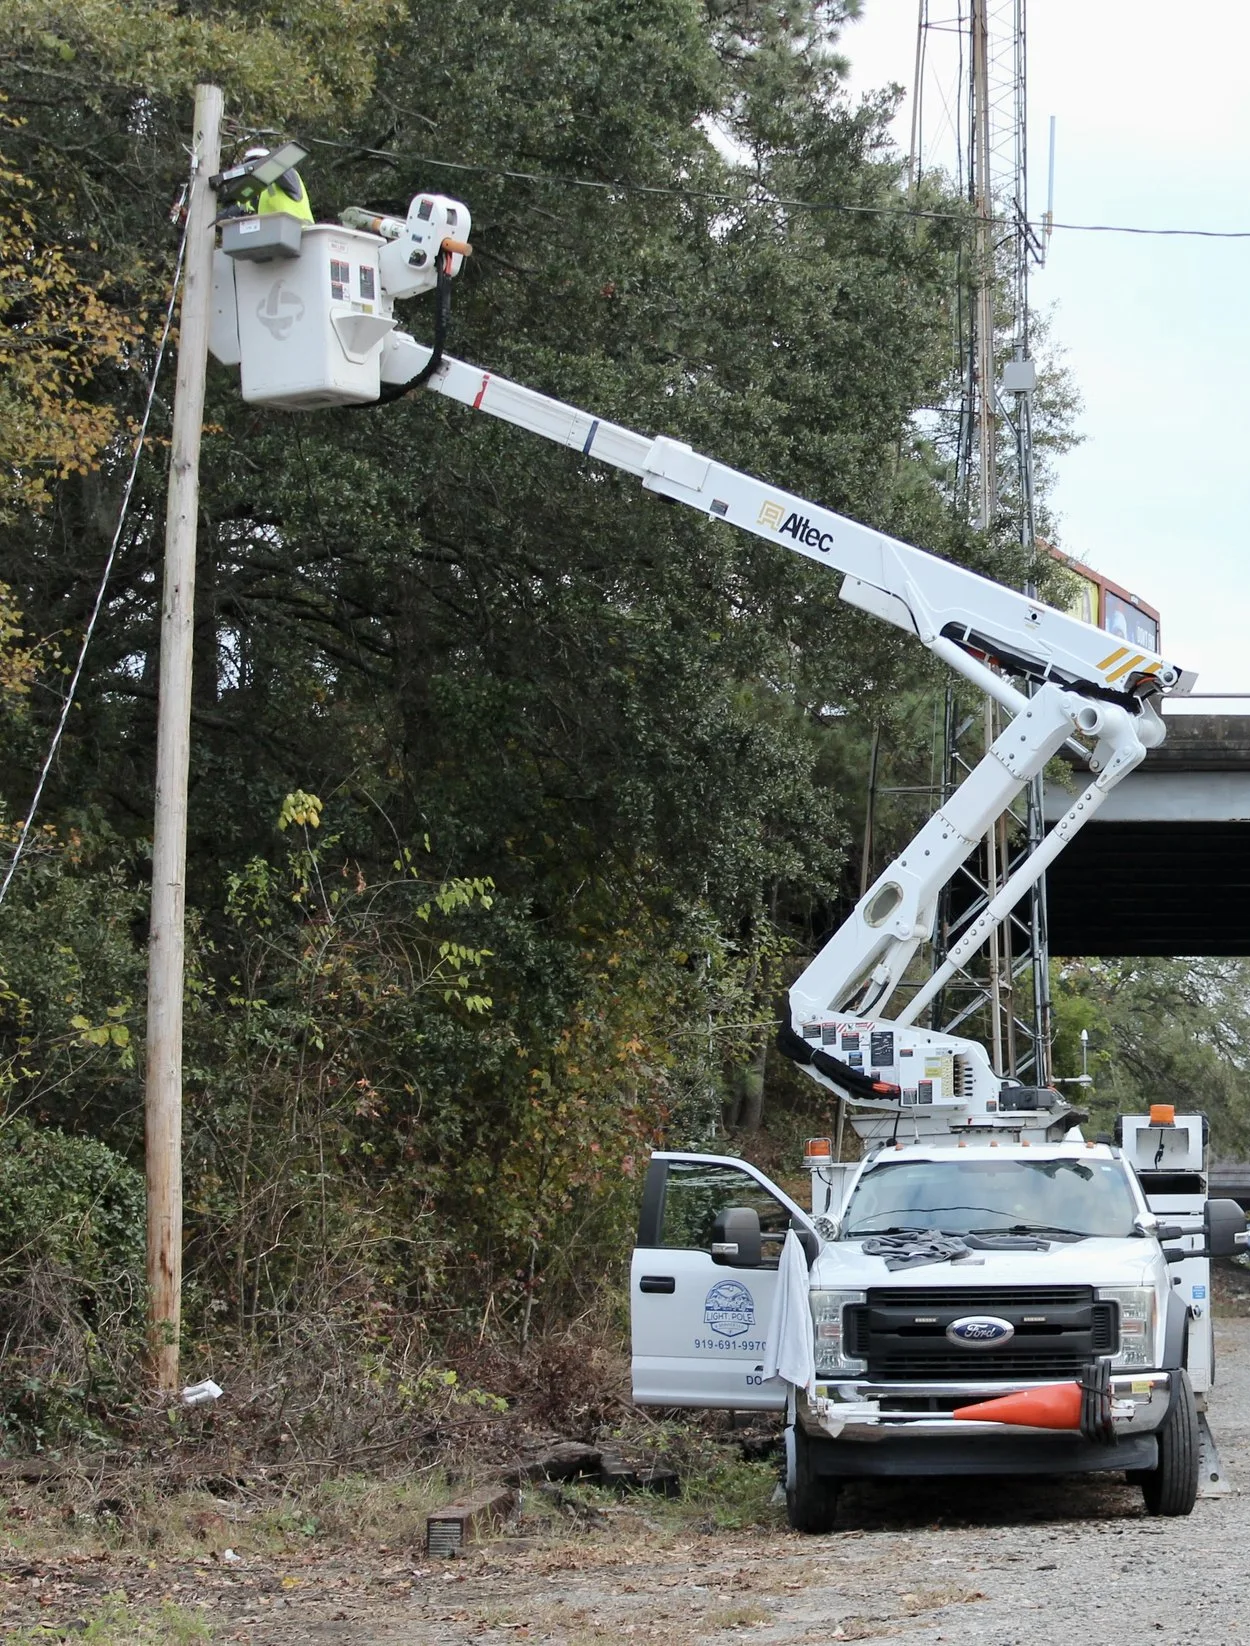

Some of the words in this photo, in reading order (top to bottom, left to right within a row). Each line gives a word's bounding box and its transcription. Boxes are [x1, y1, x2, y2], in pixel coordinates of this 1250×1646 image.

[779, 512, 834, 553] Altec
[731, 1313, 753, 1323] POLE
[964, 1323, 997, 1338] Ford
